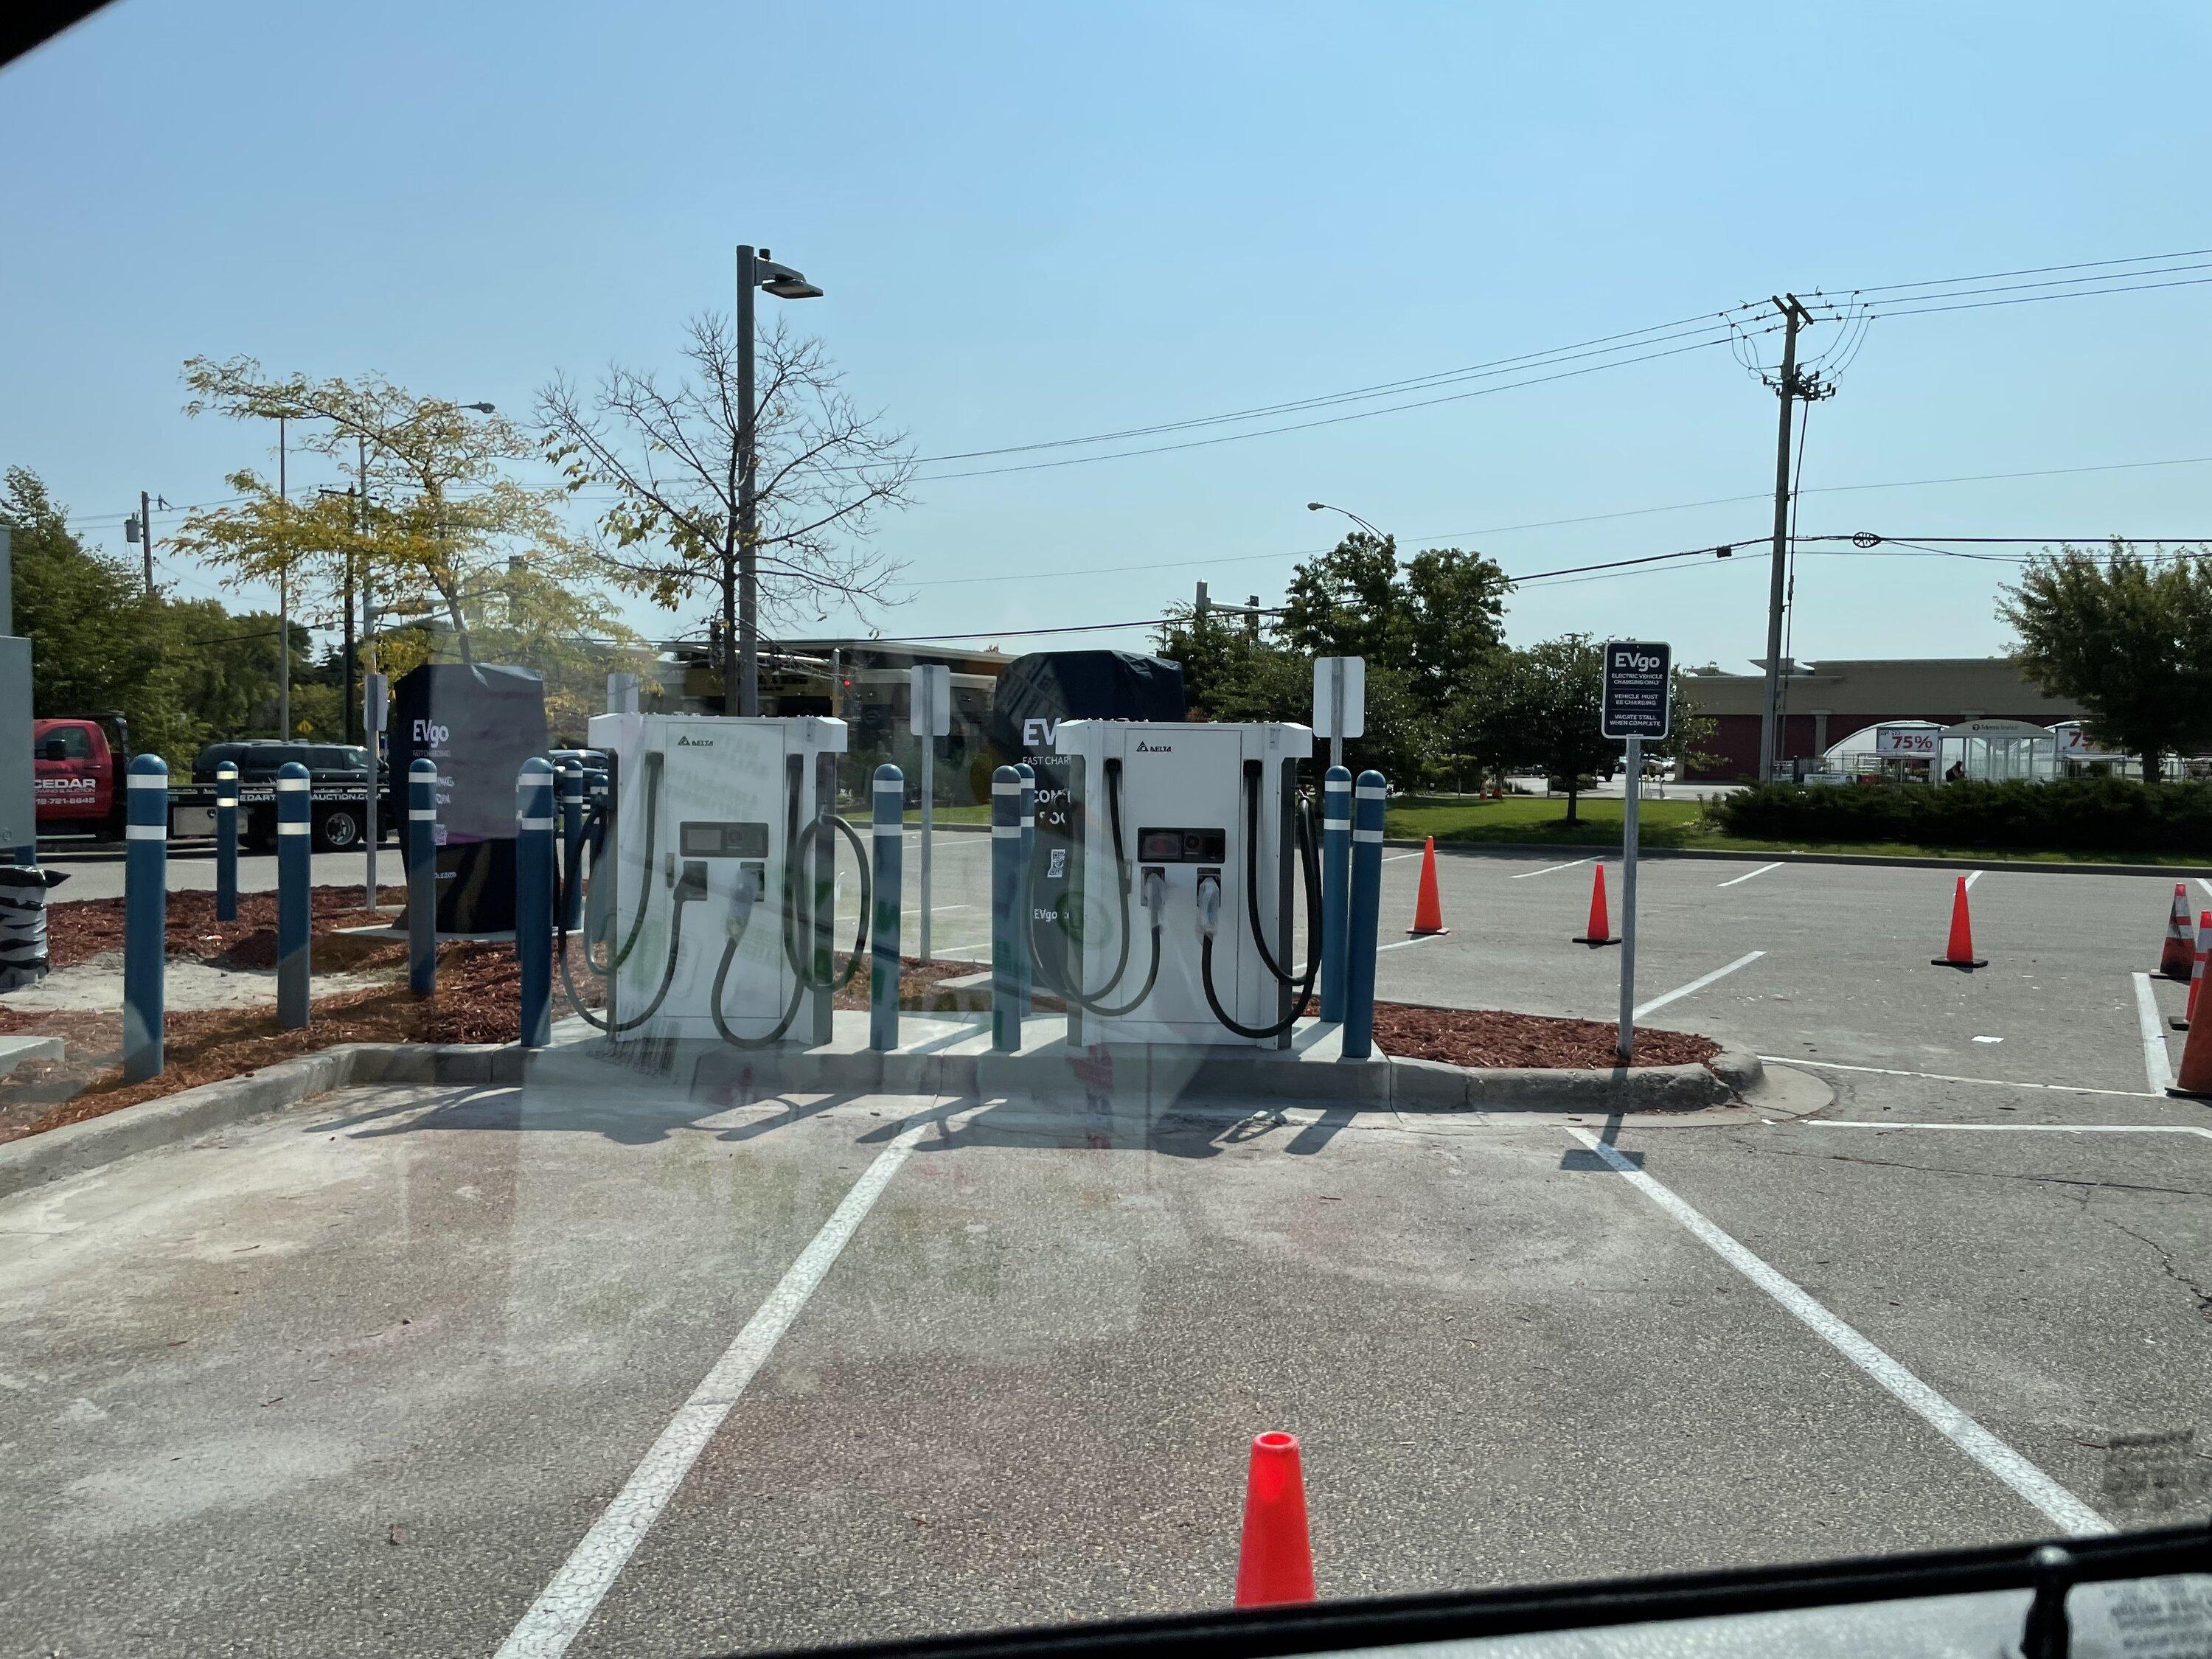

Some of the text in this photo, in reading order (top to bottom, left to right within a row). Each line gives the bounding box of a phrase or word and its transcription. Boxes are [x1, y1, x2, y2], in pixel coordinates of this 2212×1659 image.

[1615, 653, 1660, 672] EVgo
[413, 720, 449, 748] EVgo
[1023, 717, 1062, 745] EV
[1892, 736, 1933, 749] 75%
[2069, 731, 2094, 747] 75
[1023, 757, 1071, 765] FAST CHAR
[34, 779, 96, 788] CEDAR
[1034, 908, 1069, 922] EVgo
